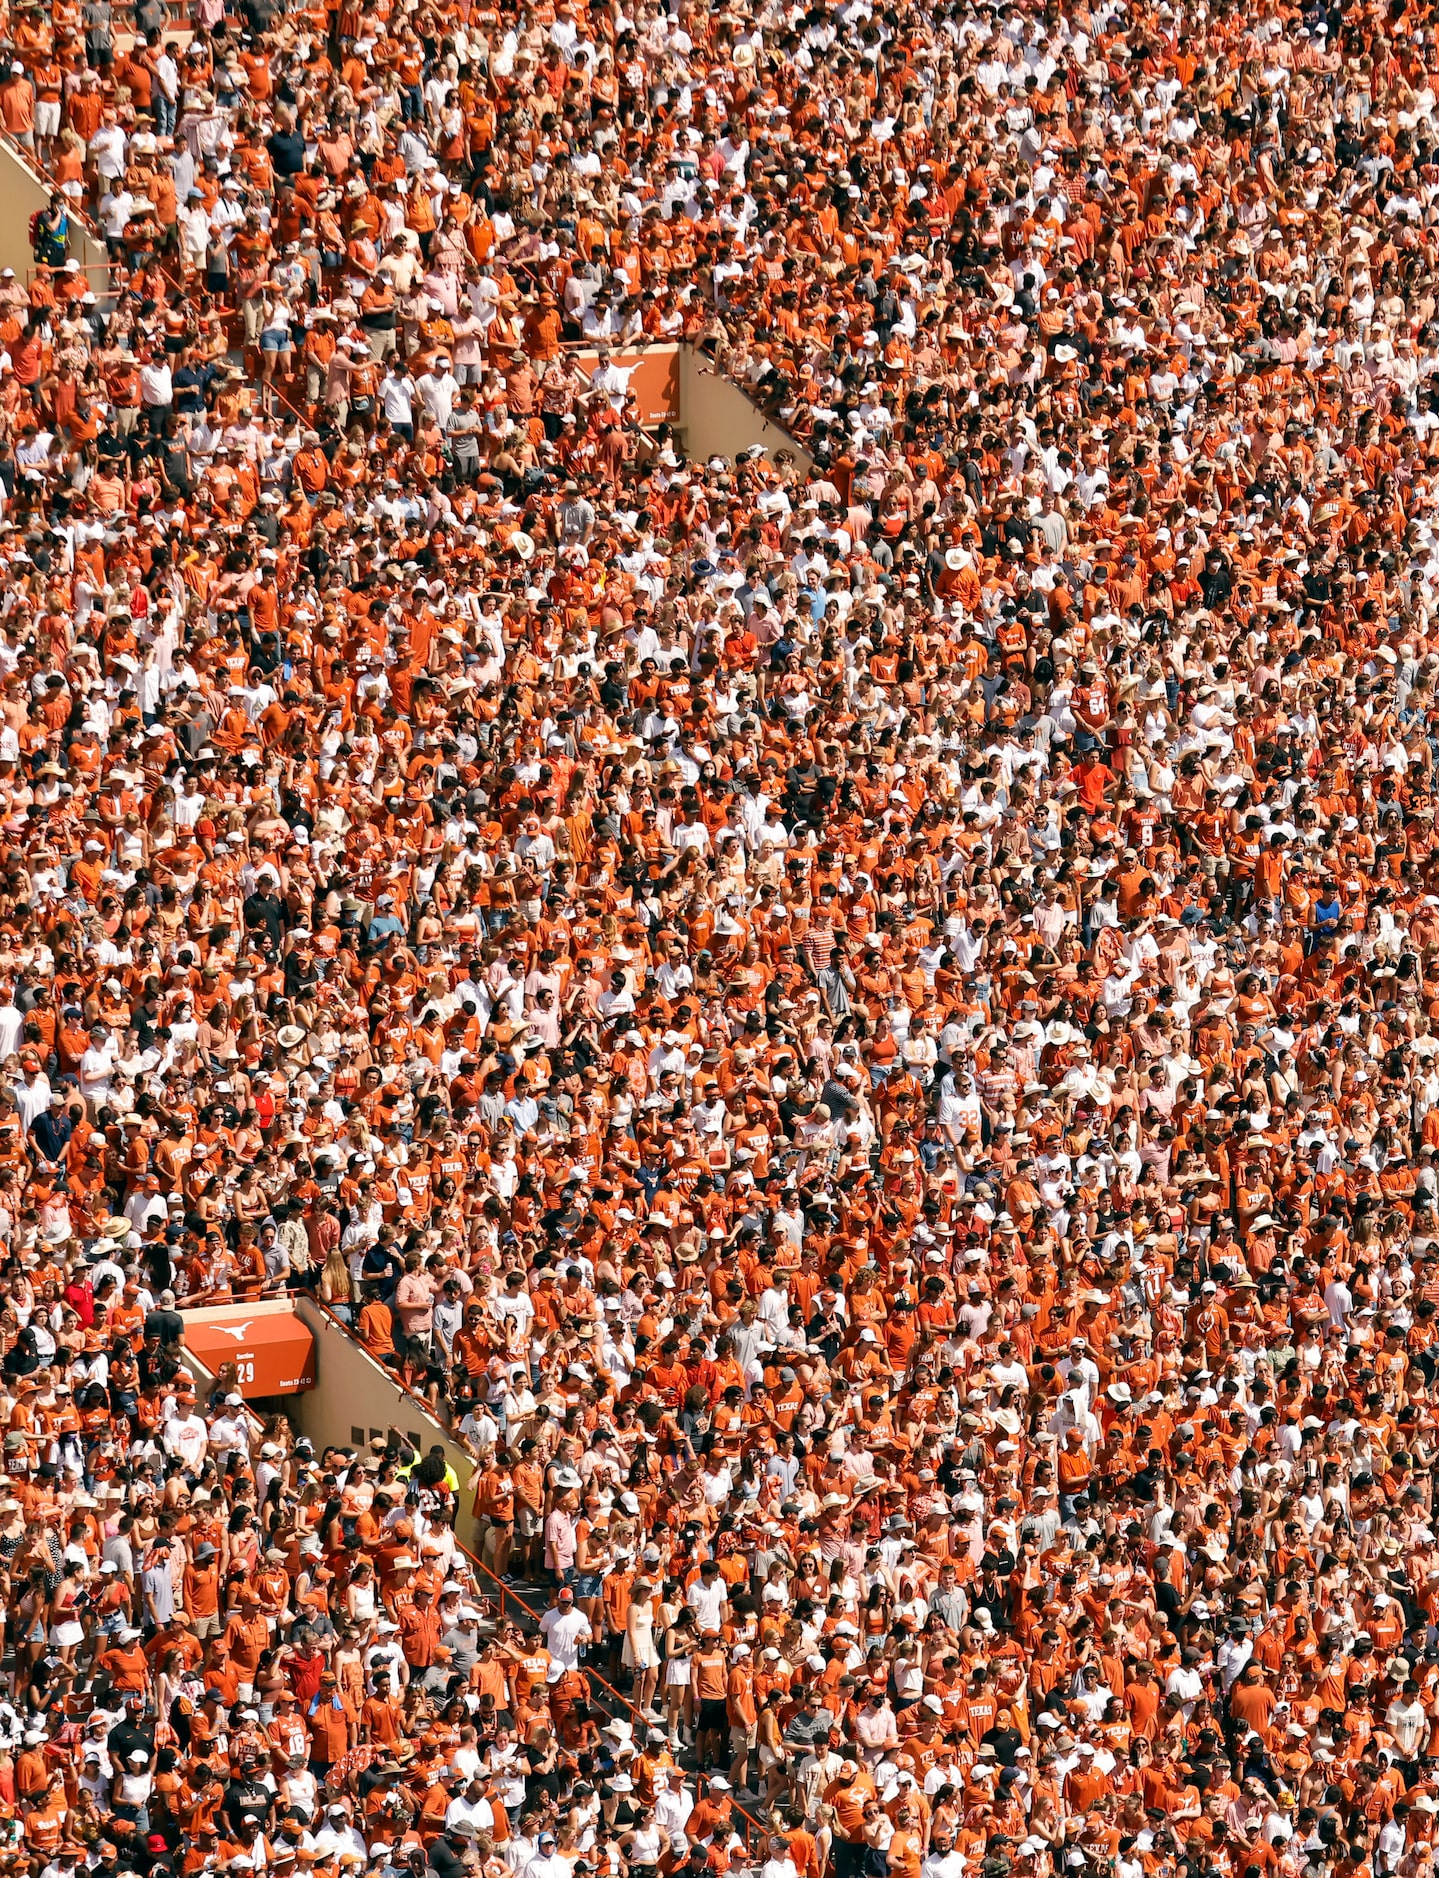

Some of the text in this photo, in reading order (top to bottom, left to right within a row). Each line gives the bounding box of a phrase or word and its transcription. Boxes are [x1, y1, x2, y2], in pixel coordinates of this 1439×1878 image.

[478, 12, 497, 21] TEXAS
[958, 649, 979, 660] TEAS
[225, 657, 246, 667] TEXAS
[669, 686, 690, 696] TEXAS
[1088, 698, 1105, 714] 64
[1342, 741, 1356, 752] TEXAS
[1412, 796, 1430, 811] 32
[1214, 820, 1220, 837] 1
[385, 1027, 408, 1039] TEXAS
[932, 1024, 938, 1036] 1
[958, 1108, 978, 1129] 32
[748, 1135, 770, 1147] TEXAS
[807, 1132, 833, 1143] TEXAS
[170, 1148, 191, 1160] TEXAS
[573, 1156, 595, 1166] TEXAS
[441, 1162, 463, 1173] TEXAS
[188, 1172, 213, 1181] TEXAS
[407, 1176, 431, 1186] TEXAS
[320, 1185, 338, 1194] TEXAS
[237, 1254, 254, 1268] TEXAS
[1219, 1254, 1239, 1265] TEXAS
[1145, 1266, 1166, 1277] TEXAS
[237, 1362, 254, 1383] 29
[775, 1401, 799, 1412] TEXAS
[7, 1457, 28, 1468] TEXAS
[354, 1495, 373, 1505] TEXAS
[522, 1658, 548, 1668] TEXAS
[969, 1705, 993, 1715] TEXAS
[1105, 1726, 1132, 1737] TEXAS
[289, 1734, 305, 1753] 18
